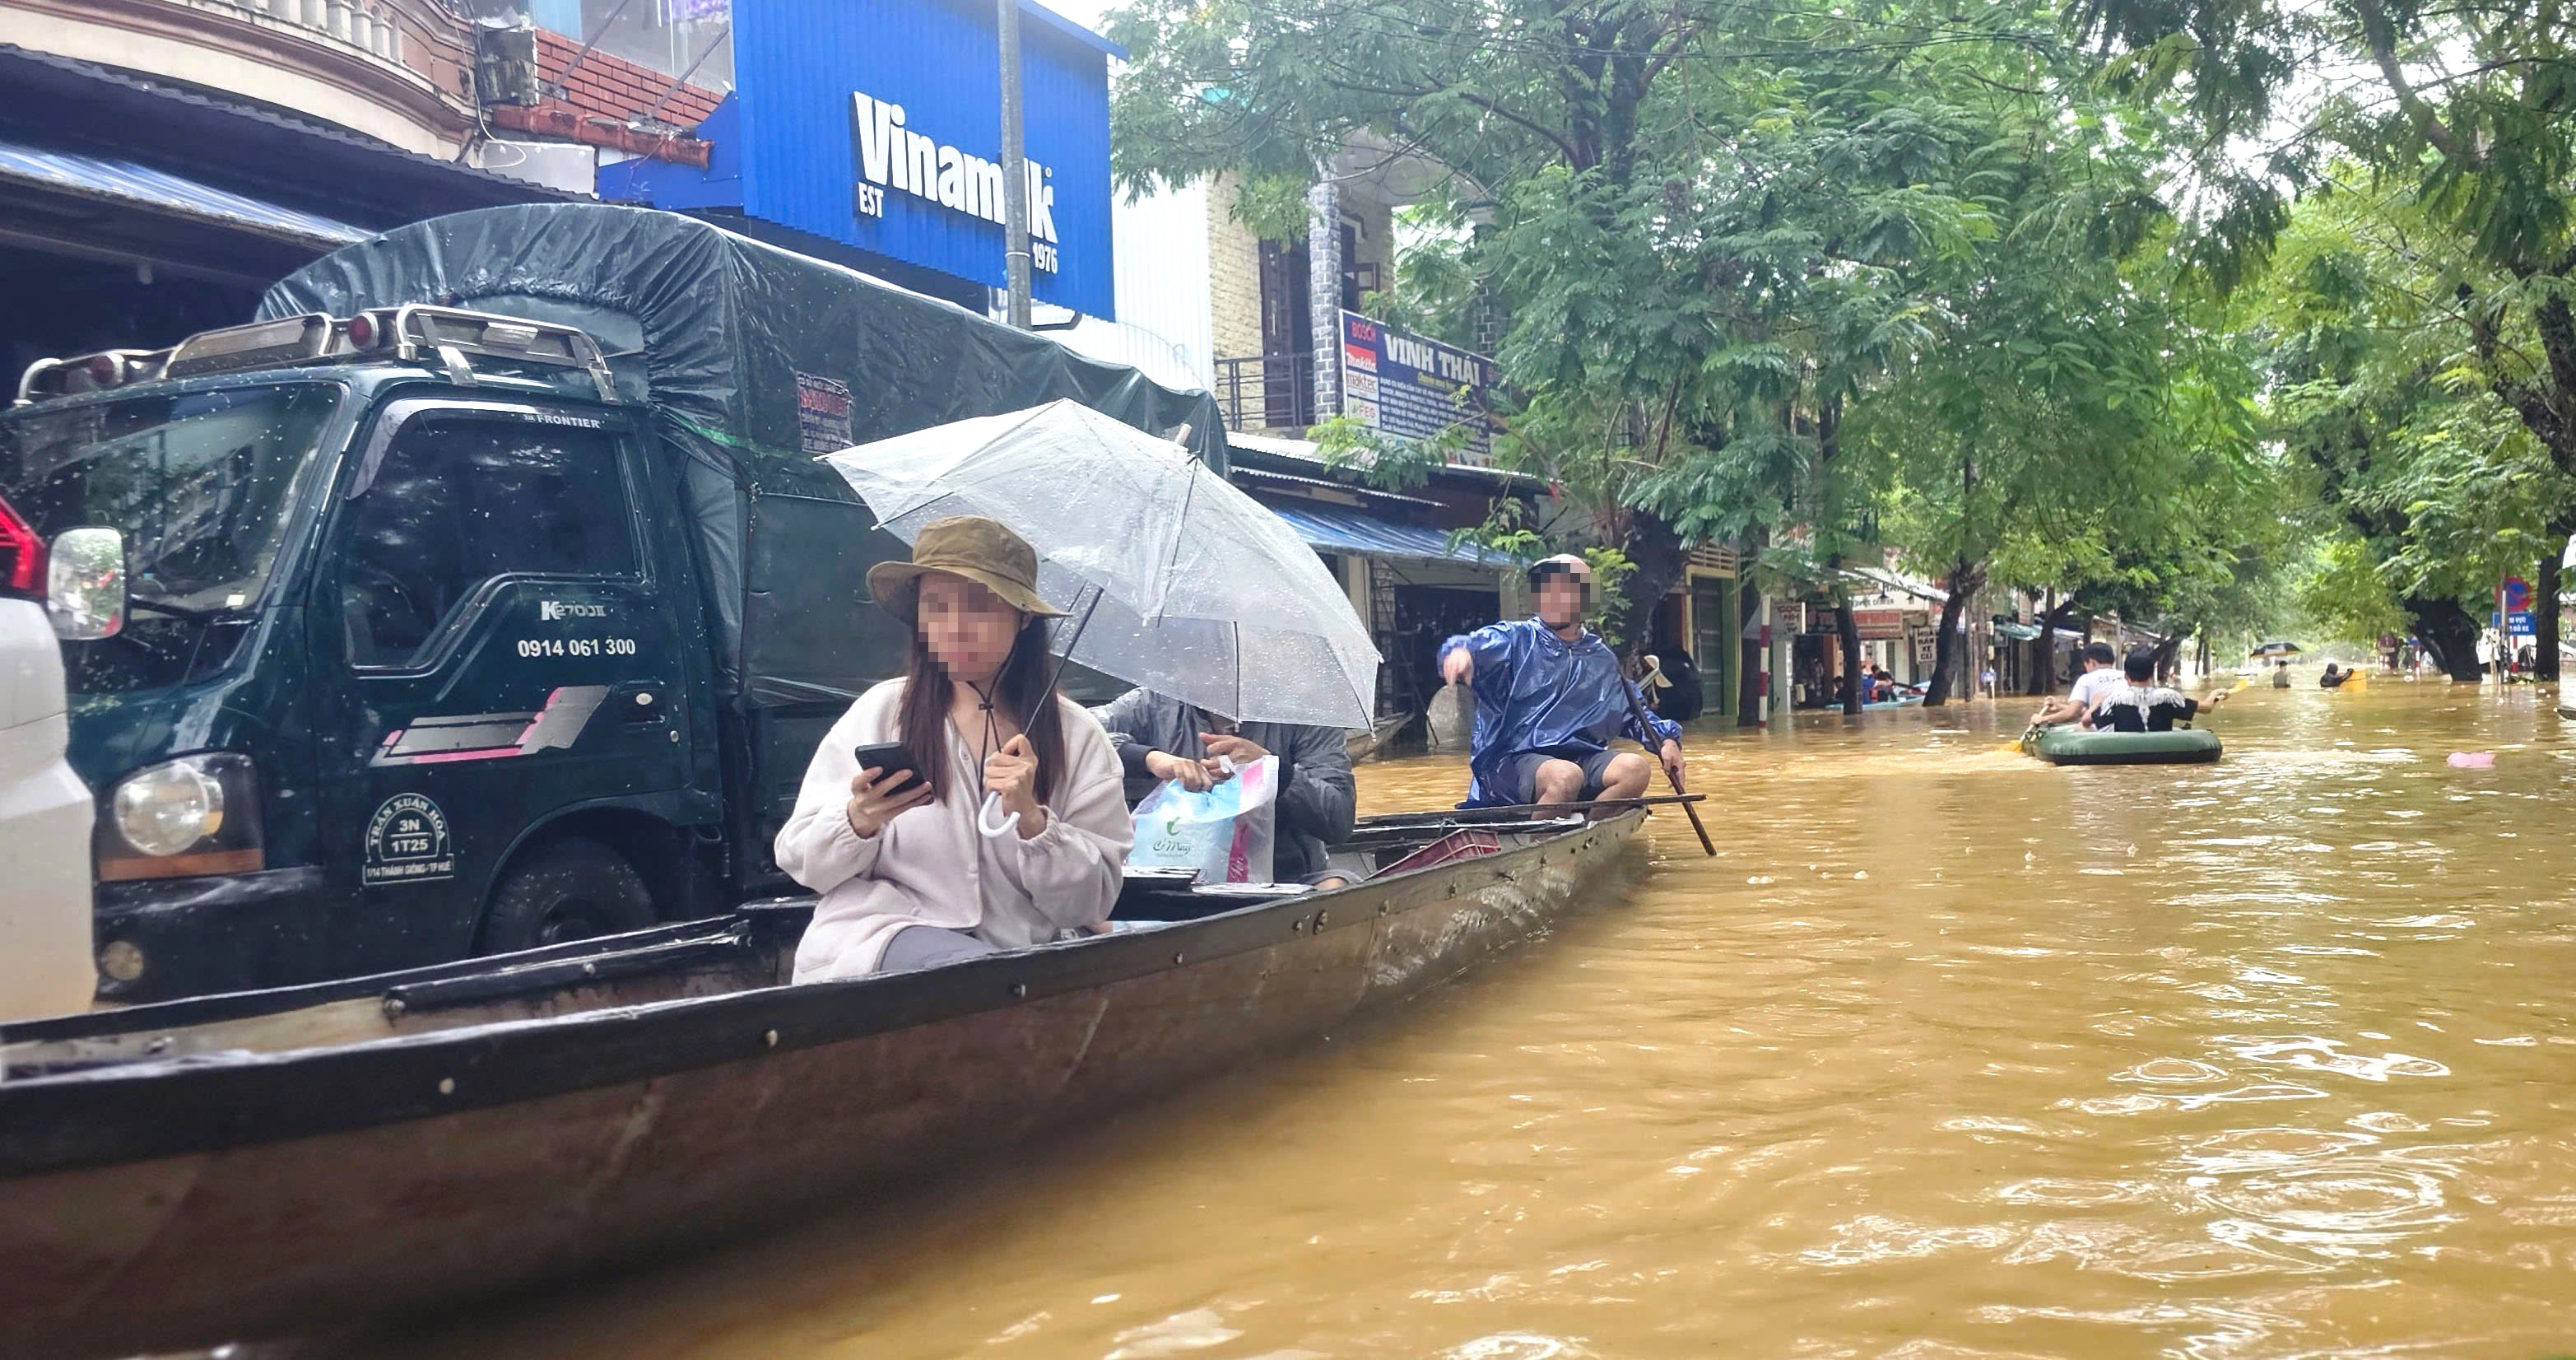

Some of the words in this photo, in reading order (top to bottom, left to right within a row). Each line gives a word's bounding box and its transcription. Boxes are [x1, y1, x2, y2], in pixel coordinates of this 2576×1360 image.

[854, 91, 1058, 244] Vinamk
[858, 181, 883, 218] EST
[1033, 242, 1058, 273] 1976
[1351, 320, 1377, 343] BOSCH
[1384, 333, 1434, 373] VINH
[1438, 351, 1481, 387] THÁI
[537, 414, 601, 429] FRONTIER
[518, 639, 565, 658] 0914
[569, 639, 599, 657] 061
[606, 638, 636, 655] 300
[398, 818, 421, 832] 3N
[391, 839, 429, 854] 1T25
